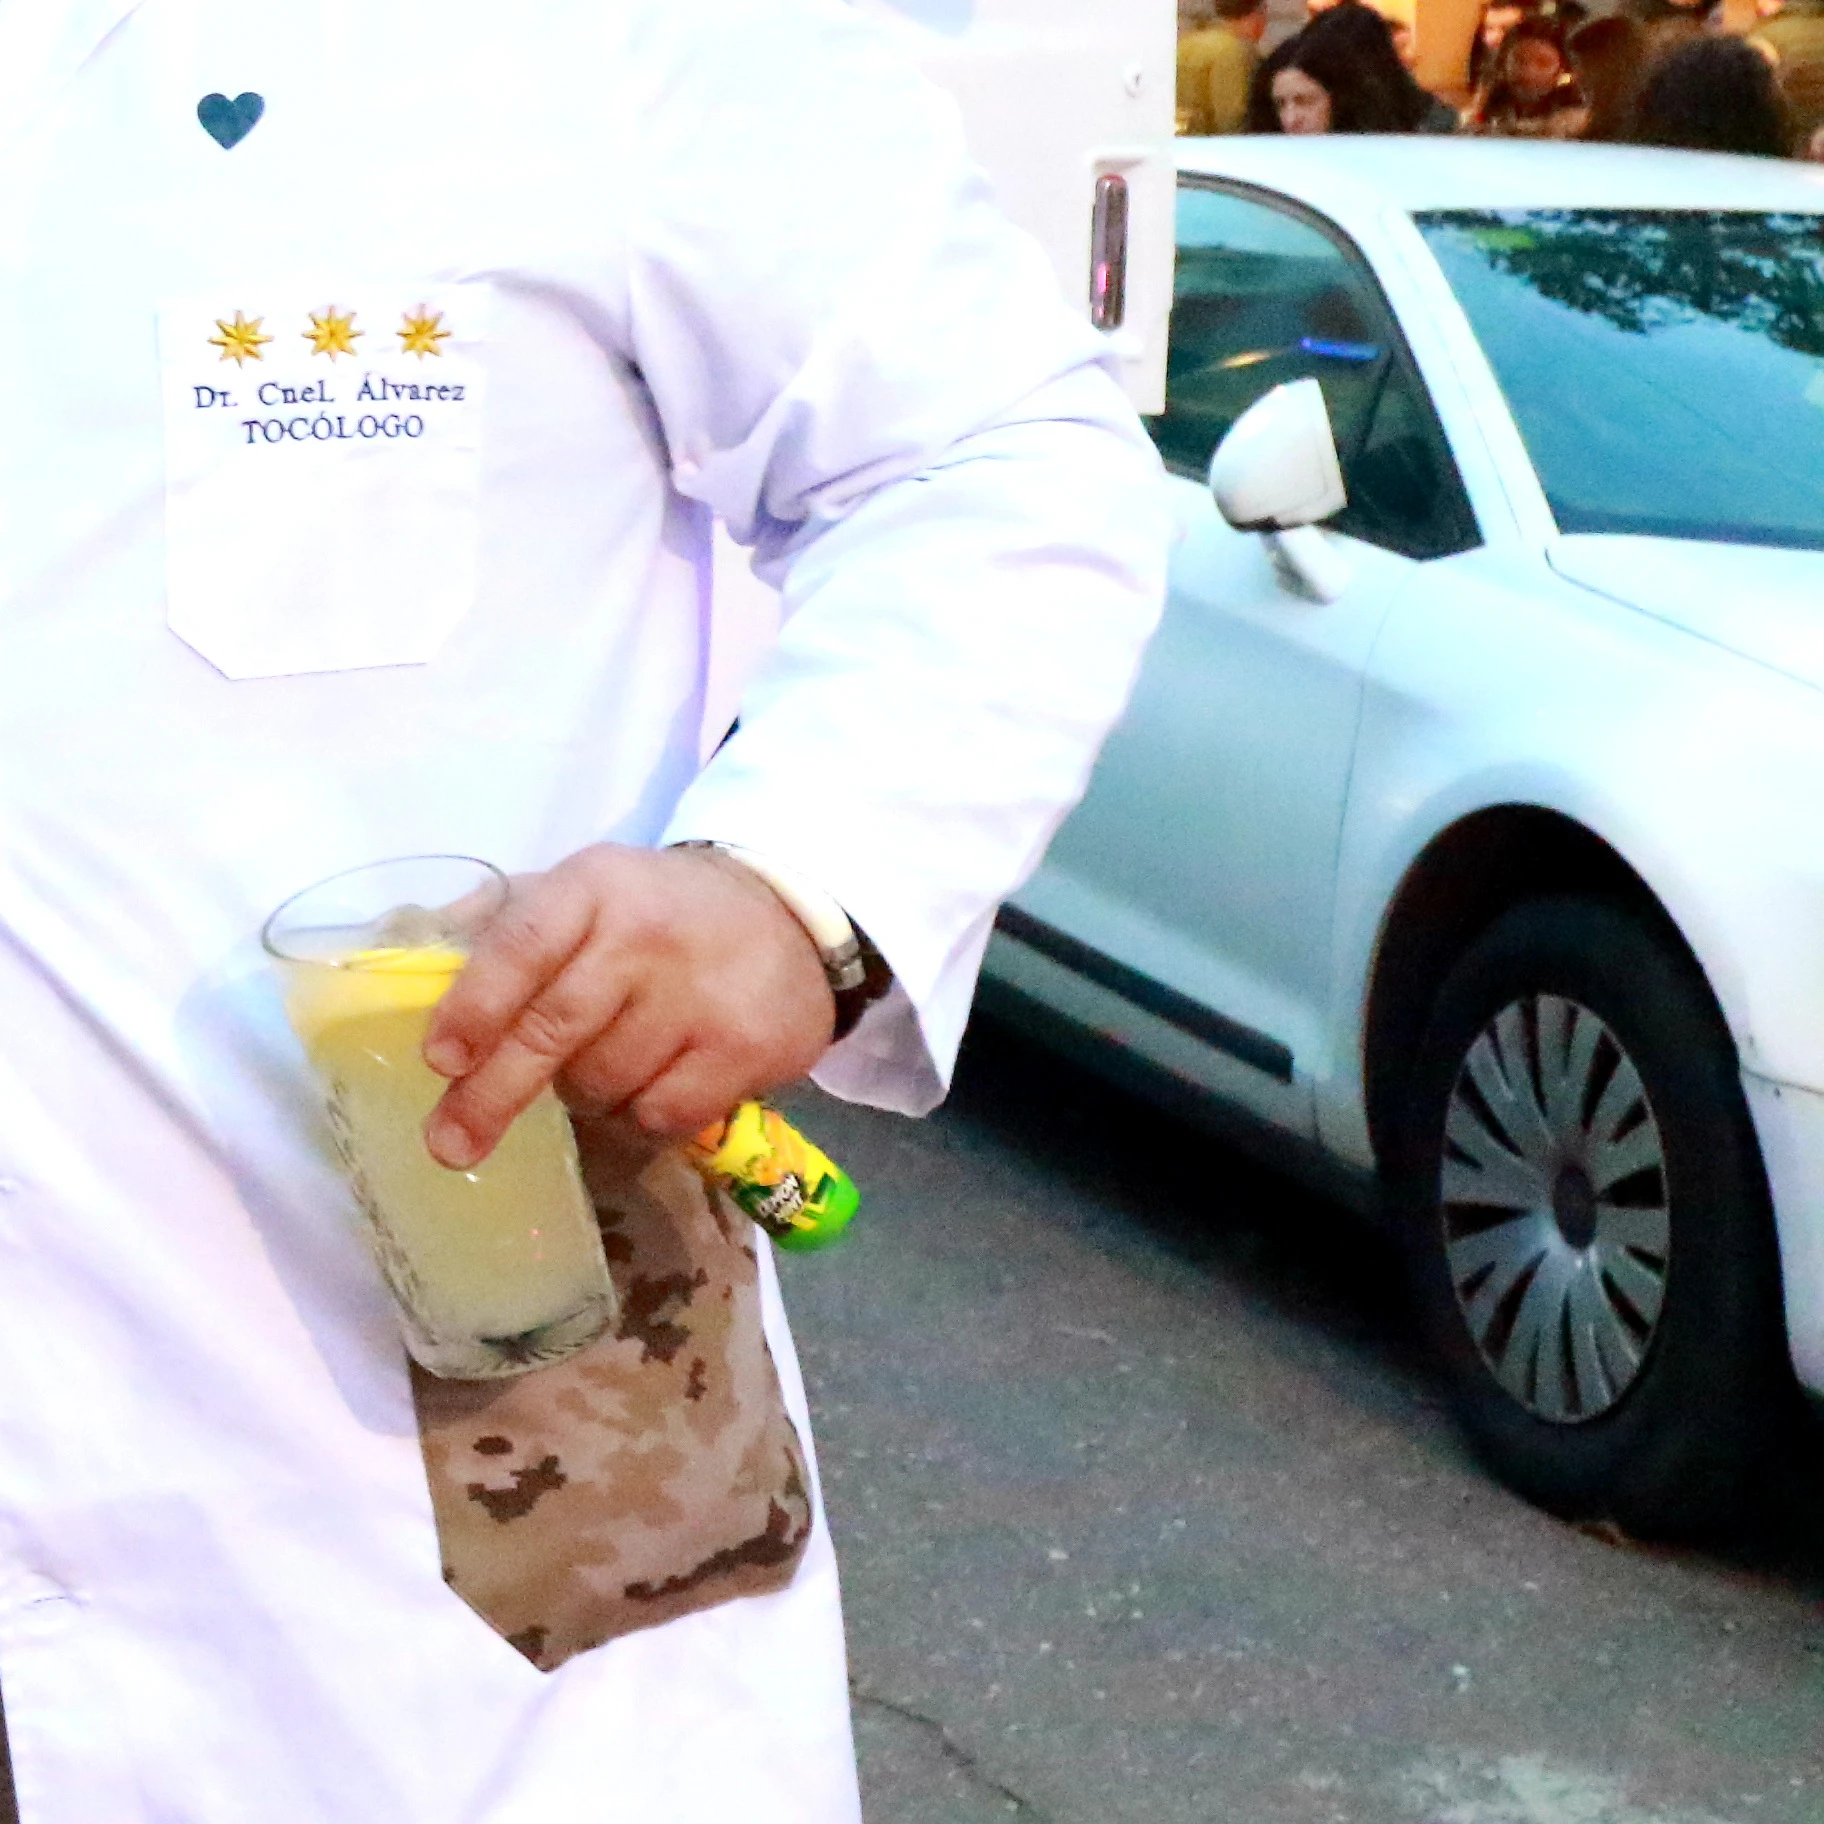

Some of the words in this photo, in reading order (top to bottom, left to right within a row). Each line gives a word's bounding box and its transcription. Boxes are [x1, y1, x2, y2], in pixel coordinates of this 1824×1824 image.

[194, 385, 238, 409] Dr.
[357, 371, 465, 402] Álvarez
[241, 410, 425, 444] TOCÓLOGO
